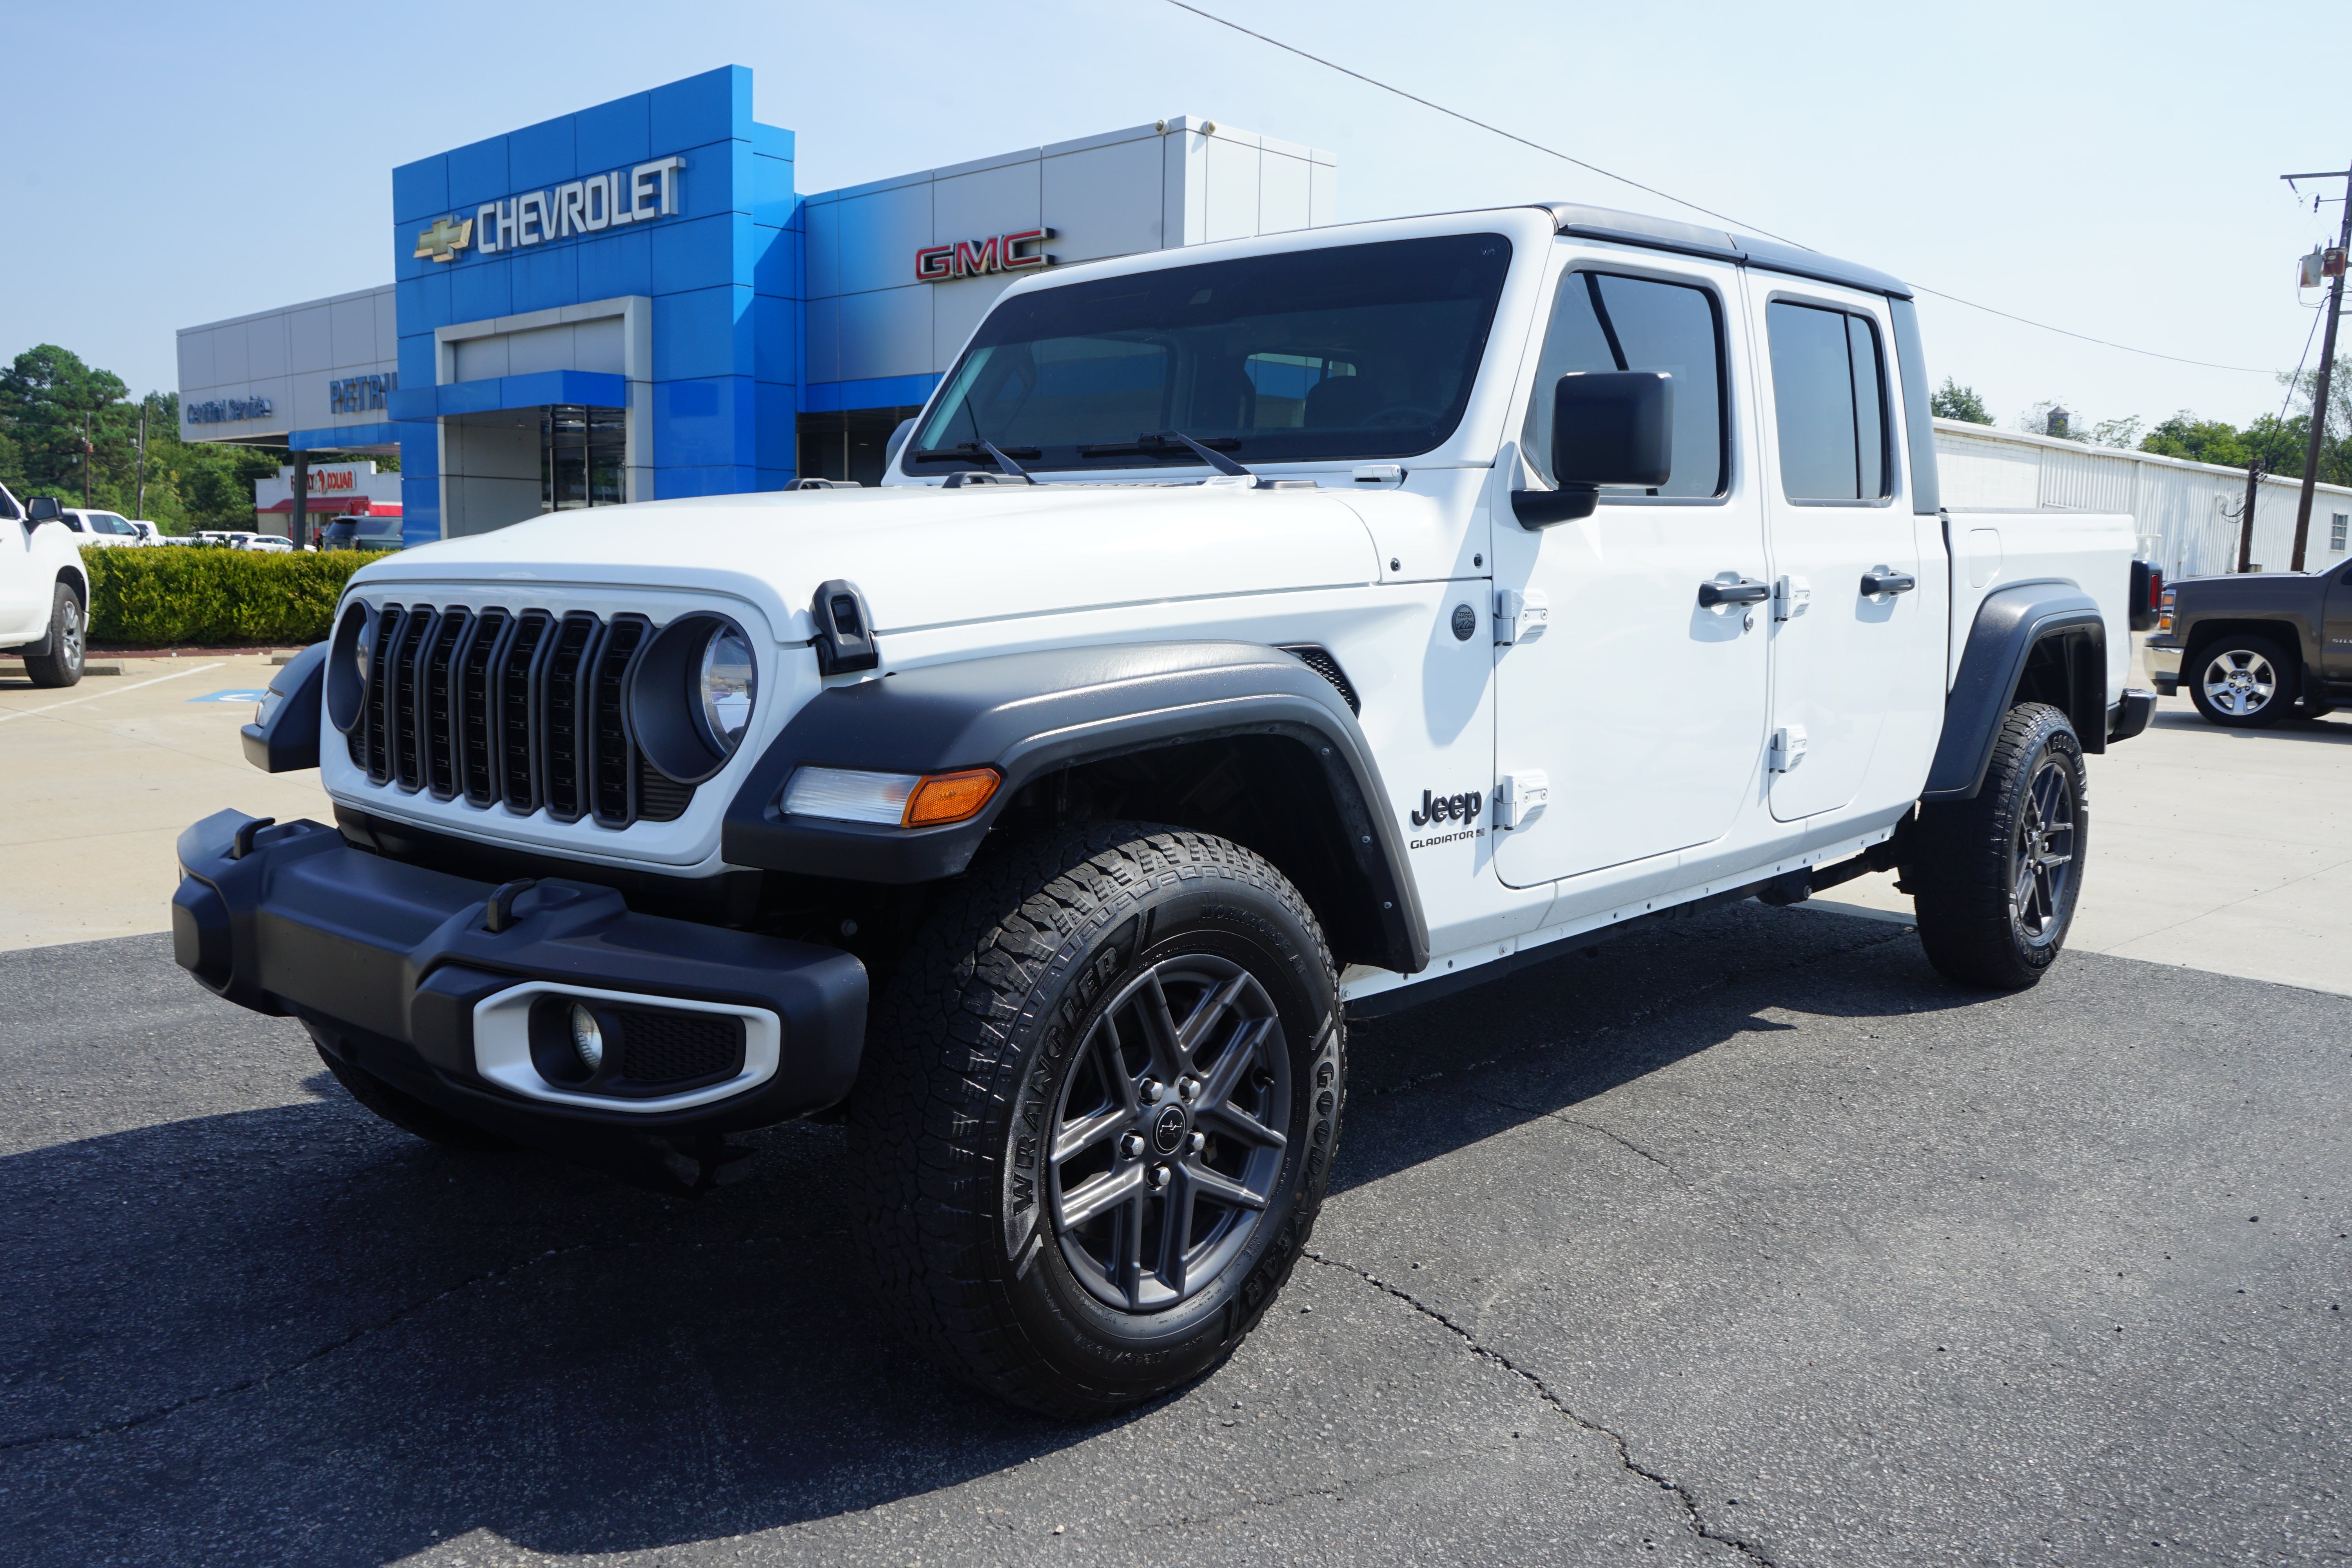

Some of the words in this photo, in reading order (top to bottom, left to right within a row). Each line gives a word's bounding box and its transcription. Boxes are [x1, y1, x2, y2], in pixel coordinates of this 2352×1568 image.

[477, 156, 686, 254] CHEVROLET
[916, 227, 1053, 283] GMC
[187, 399, 226, 424] Certified
[229, 396, 267, 421] Service
[327, 471, 353, 490] DOLLAR
[1412, 788, 1482, 826] Jeep
[1410, 830, 1474, 849] GLADIATOR
[1201, 905, 1291, 953] WORKHORSE
[1013, 947, 1118, 1216] WRANGLER
[1248, 1062, 1334, 1307] GOODYEAR
